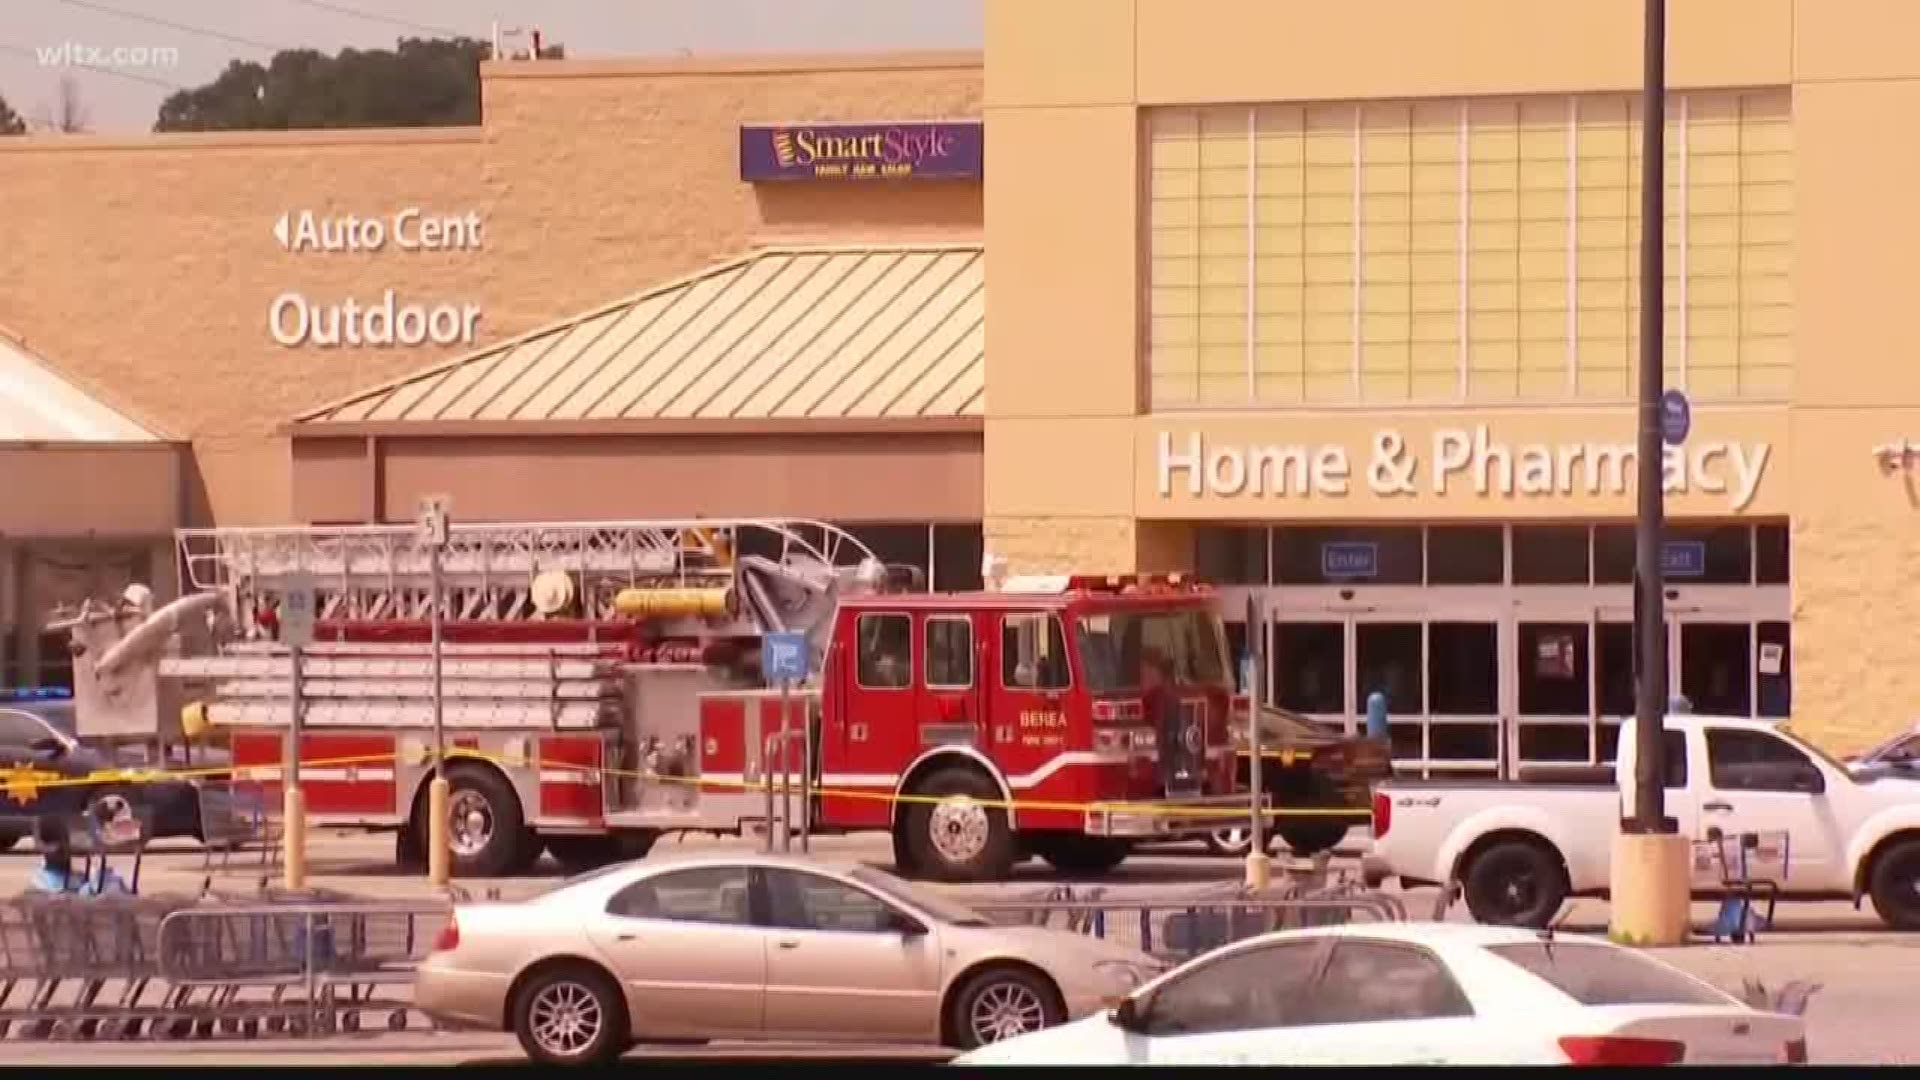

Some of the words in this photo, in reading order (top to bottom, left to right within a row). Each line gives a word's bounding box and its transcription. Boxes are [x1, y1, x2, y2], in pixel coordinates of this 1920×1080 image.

[294, 210, 385, 250] Auto
[395, 207, 481, 249] Cent
[269, 288, 480, 346] Outdoor
[1157, 431, 1350, 496] Home
[1366, 427, 1417, 494] &
[1431, 422, 1770, 511] Pharmacy
[1328, 551, 1369, 569] Enter
[1019, 711, 1068, 728] BEREA
